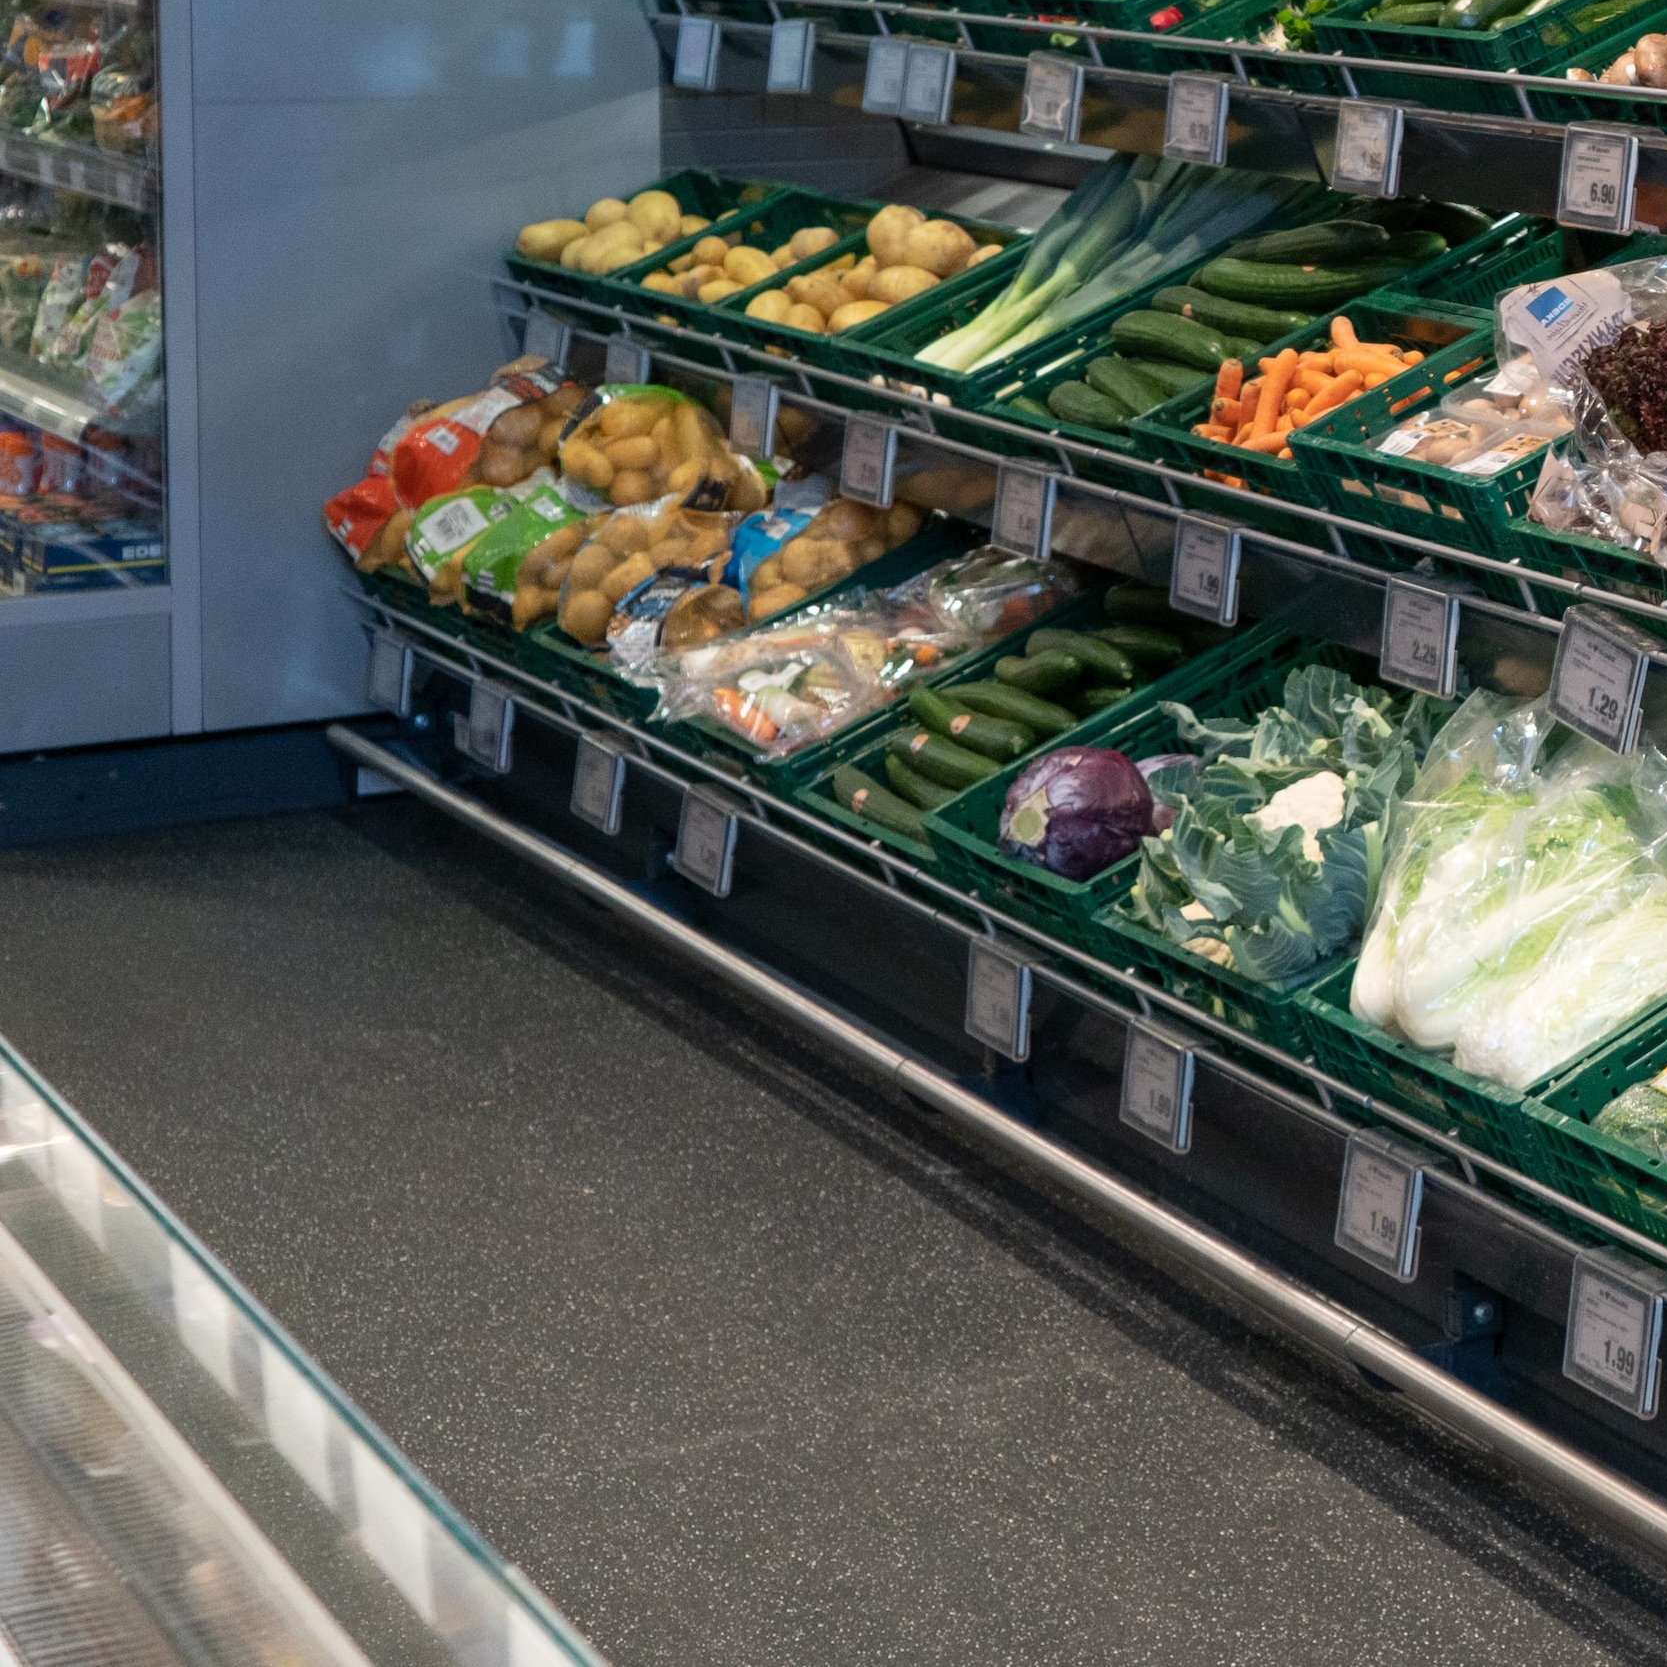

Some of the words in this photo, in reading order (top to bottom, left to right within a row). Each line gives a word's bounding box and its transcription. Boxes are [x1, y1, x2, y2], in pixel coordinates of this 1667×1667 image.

[1590, 182, 1616, 206] 6.90
[122, 544, 162, 561] EDE
[1588, 686, 1620, 722] 1.29
[1603, 1340, 1636, 1377] 1.99
